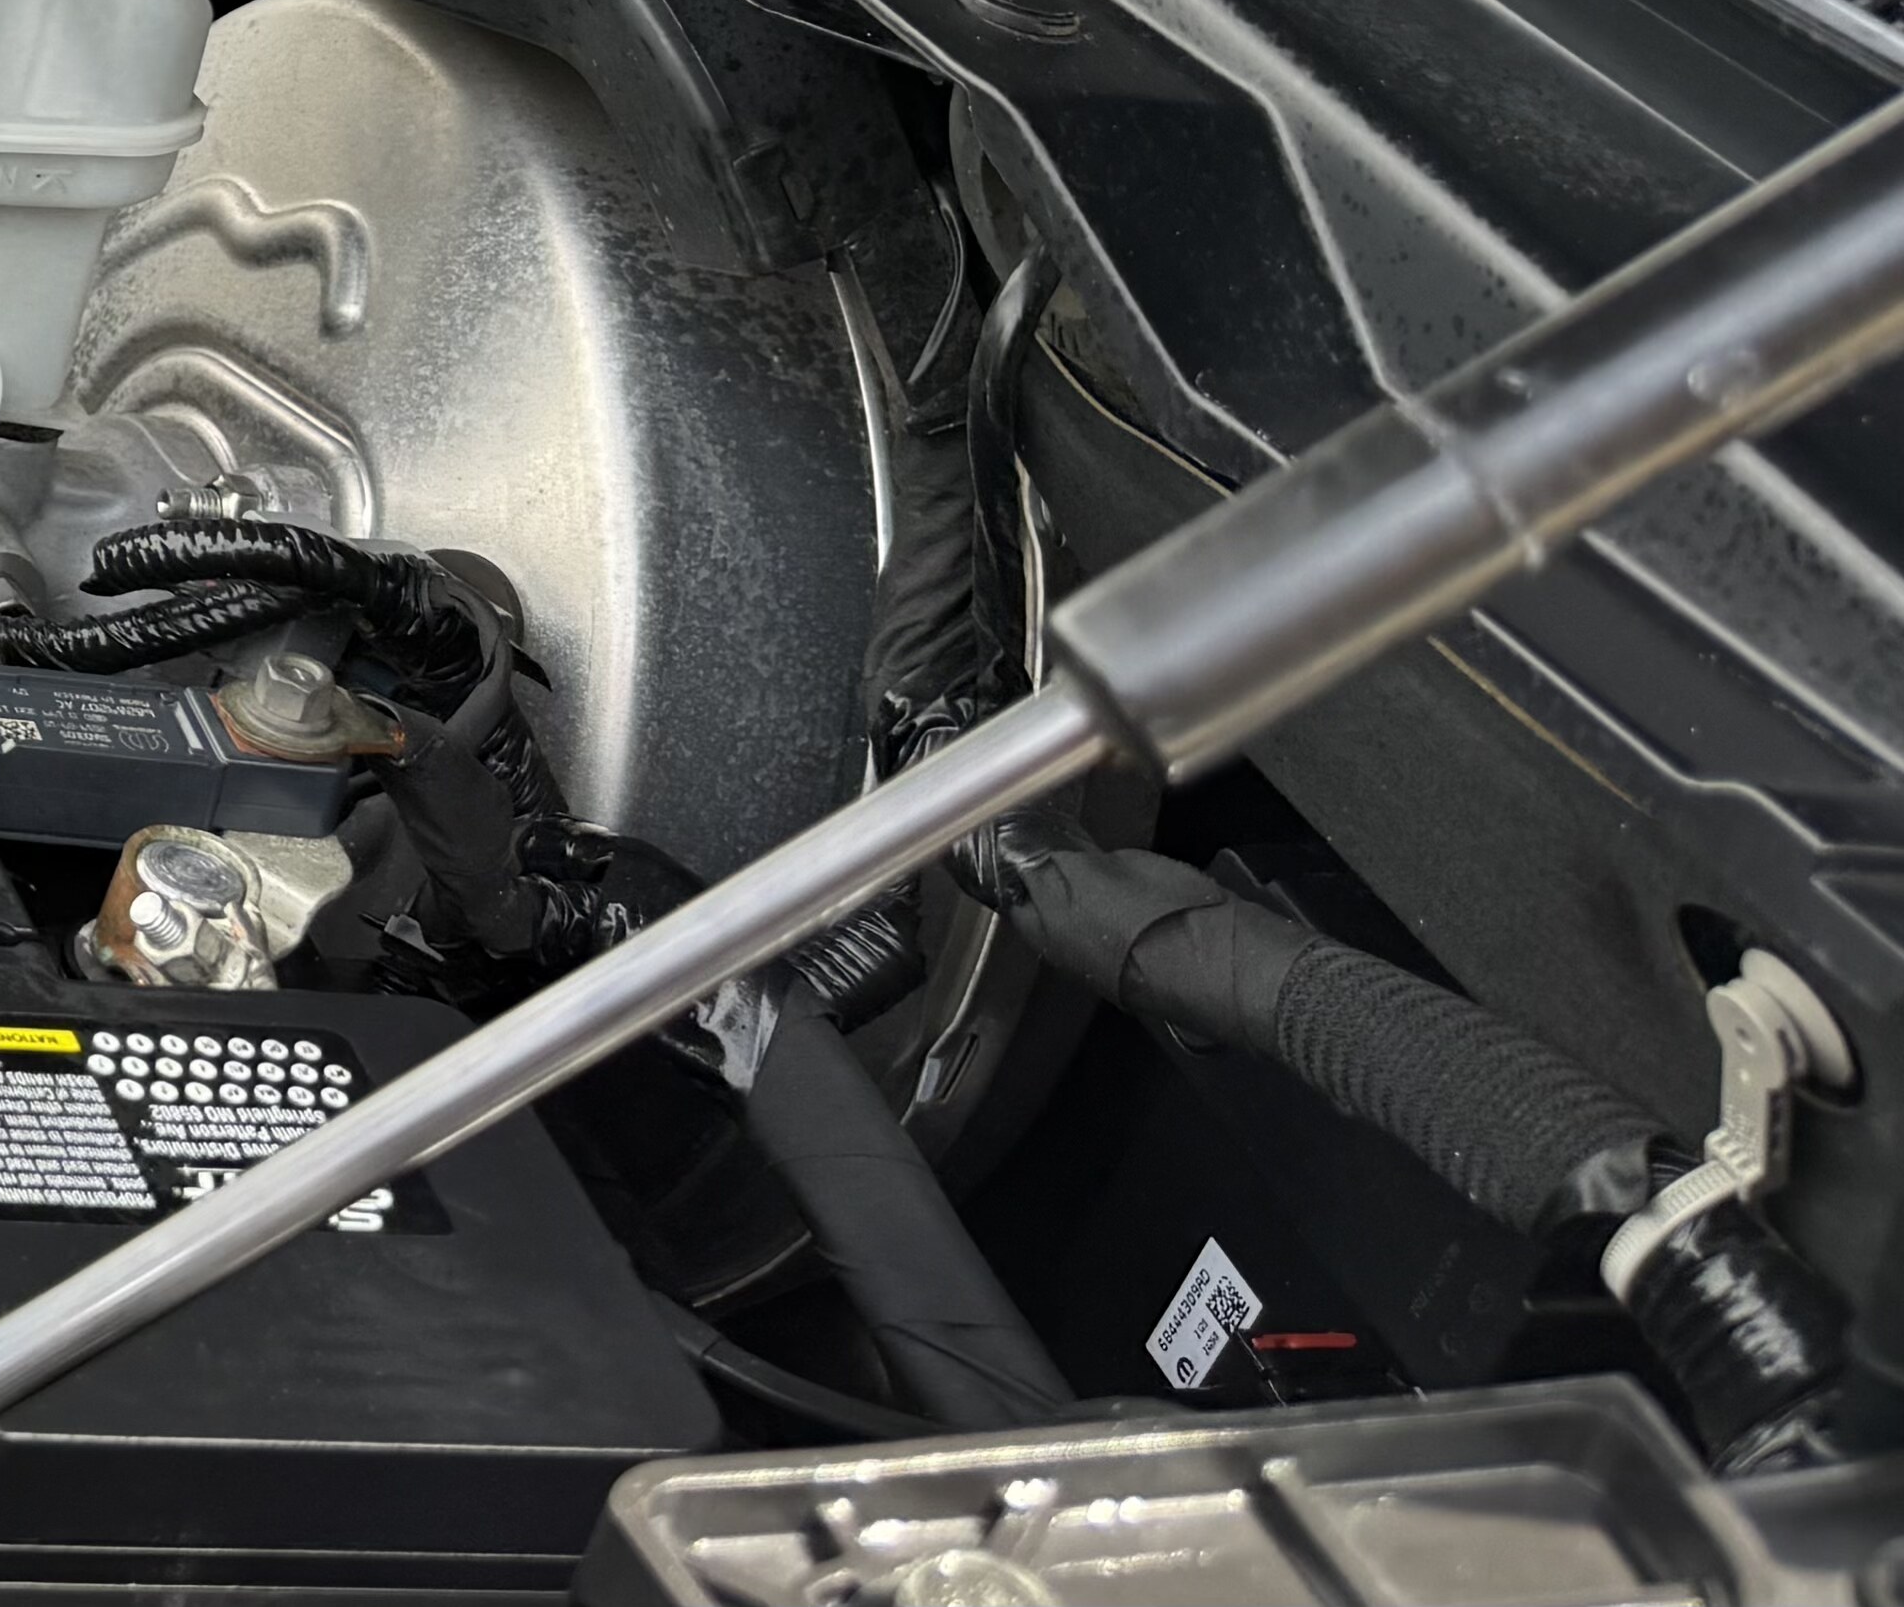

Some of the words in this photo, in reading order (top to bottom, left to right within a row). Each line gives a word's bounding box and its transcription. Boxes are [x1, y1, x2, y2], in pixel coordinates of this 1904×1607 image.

[203, 1105, 235, 1121] MO
[235, 1105, 327, 1123] Springfield
[187, 1123, 269, 1139] Patterson
[62, 1190, 157, 1209] PROPOSITION
